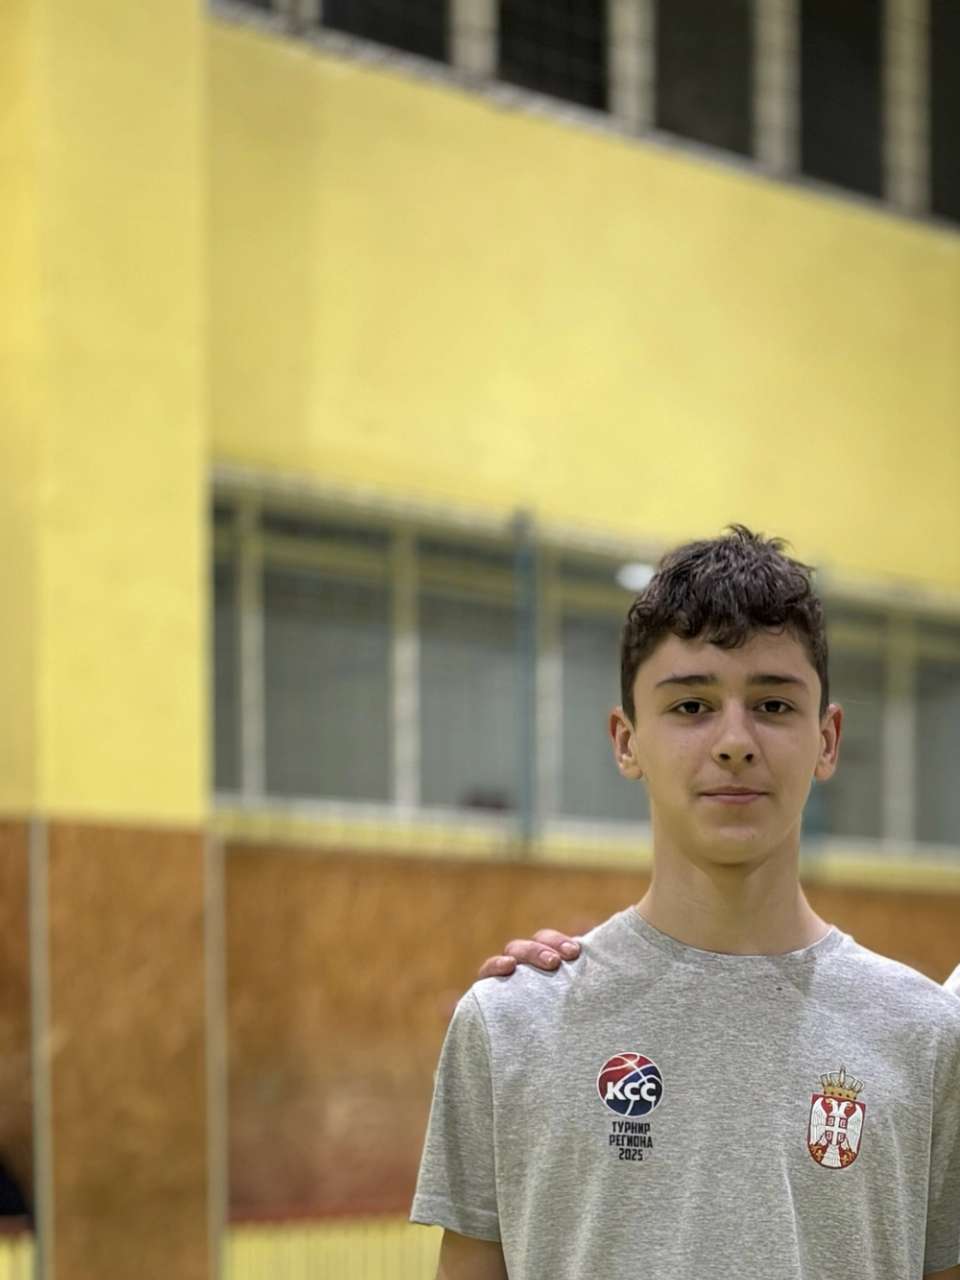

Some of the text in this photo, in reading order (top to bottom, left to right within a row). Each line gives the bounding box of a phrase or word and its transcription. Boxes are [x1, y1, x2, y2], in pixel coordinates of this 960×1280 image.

[612, 1121, 650, 1134] ТУРНИР
[609, 1134, 653, 1148] РЕГИОНА
[618, 1148, 644, 1161] 2025
